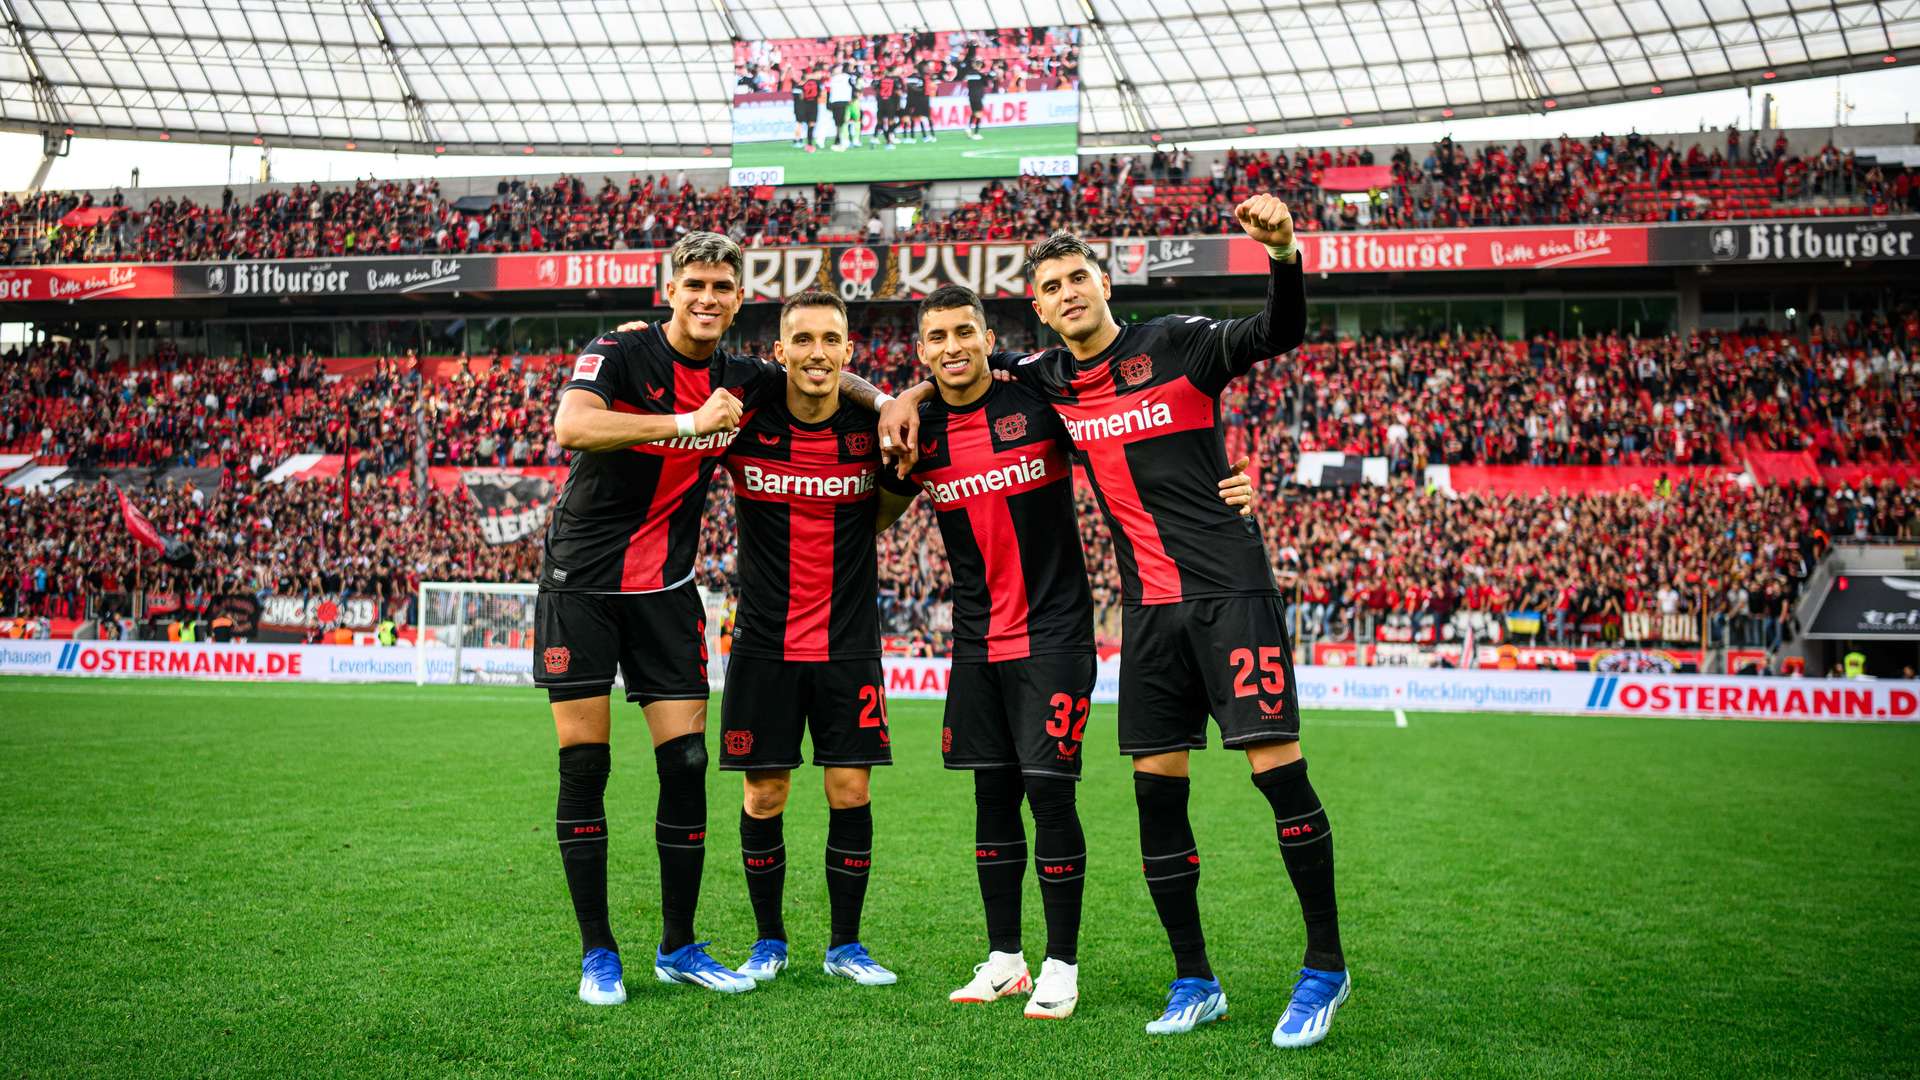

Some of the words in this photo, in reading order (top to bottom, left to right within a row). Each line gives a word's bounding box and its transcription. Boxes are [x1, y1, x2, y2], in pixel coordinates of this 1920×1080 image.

[1318, 236, 1467, 269] Bitburger
[1574, 229, 1612, 251] Bit
[1748, 224, 1913, 260] Bitburger
[109, 268, 136, 286] Bit
[232, 264, 349, 294] Bitburger
[431, 259, 461, 278] Bit
[565, 256, 657, 287] Bitbur
[744, 465, 876, 497] Barmenia
[922, 455, 1047, 503] Barmenia
[80, 647, 302, 675] OSTERMANN.DE
[329, 655, 412, 674] Leverkusen
[1230, 646, 1285, 698] 25
[1343, 679, 1389, 697] Haan
[1406, 680, 1552, 703] Recklinghausen
[859, 684, 888, 728] 20
[1046, 692, 1090, 742] 32
[1282, 824, 1312, 838] B04
[748, 856, 774, 867] B04
[1043, 865, 1074, 874] B04
